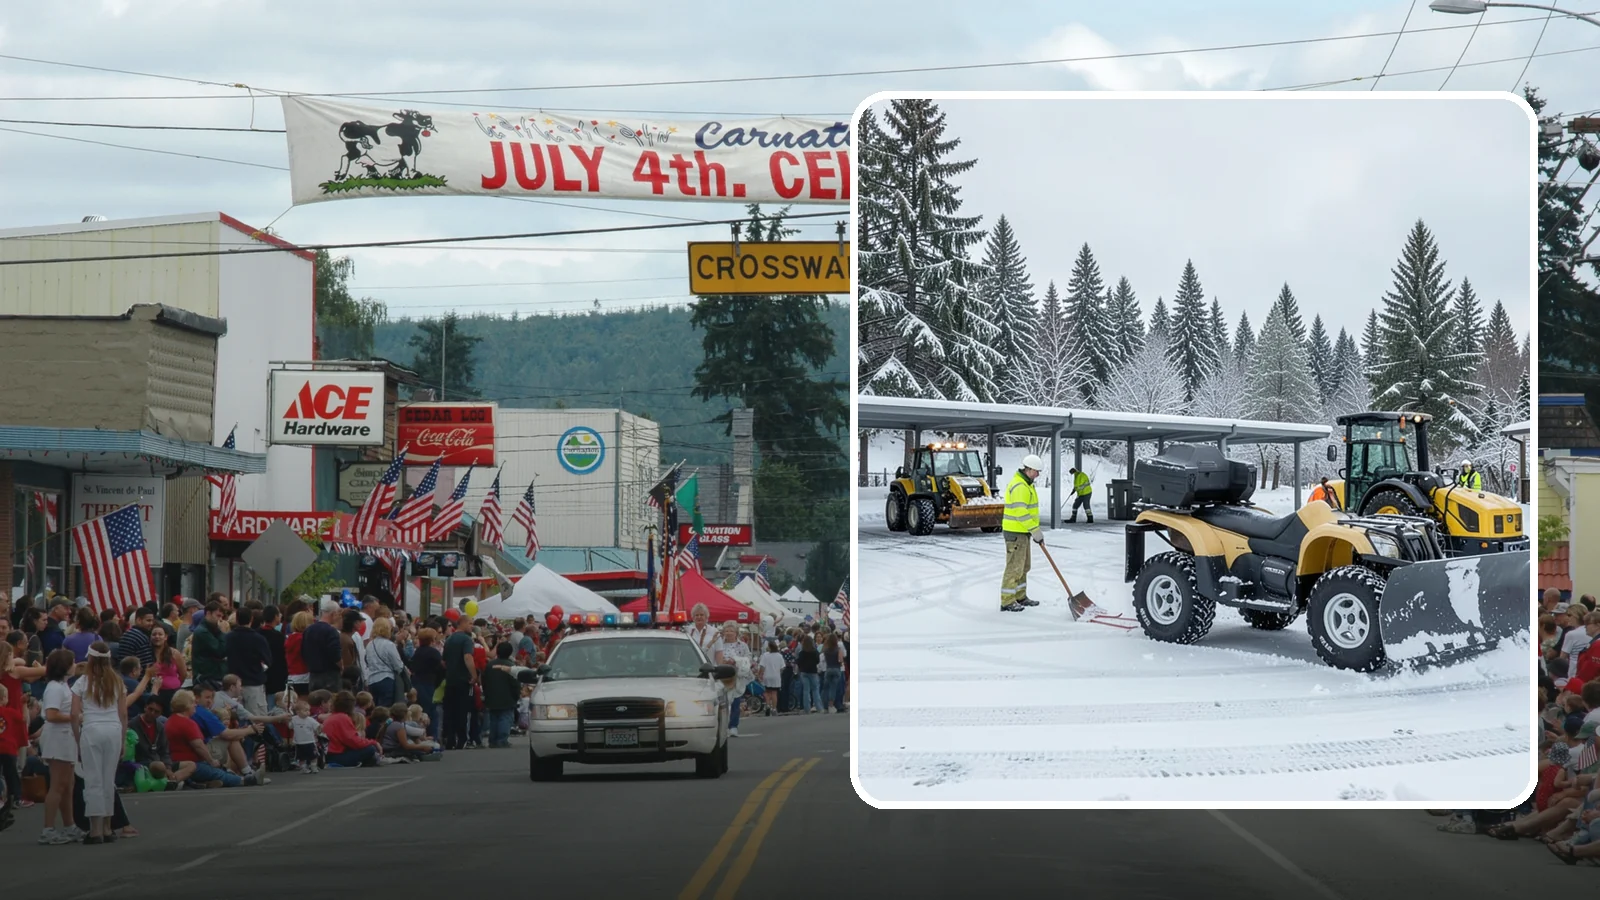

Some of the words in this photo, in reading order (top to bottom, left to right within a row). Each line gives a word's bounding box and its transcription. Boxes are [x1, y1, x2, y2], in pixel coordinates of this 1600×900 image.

[481, 141, 605, 192] JULY
[632, 150, 746, 197] 4th.
[697, 254, 850, 279] CROSSWA
[283, 380, 374, 419] ACE
[405, 409, 452, 422] CEDAR
[283, 421, 371, 436] Hardware
[353, 467, 388, 481] Simpl
[83, 486, 93, 494] St.
[95, 485, 124, 495] Vincent
[126, 486, 136, 494] de
[138, 486, 155, 495] Paul
[688, 527, 742, 535] CRNATION
[698, 535, 731, 543] GLASS
